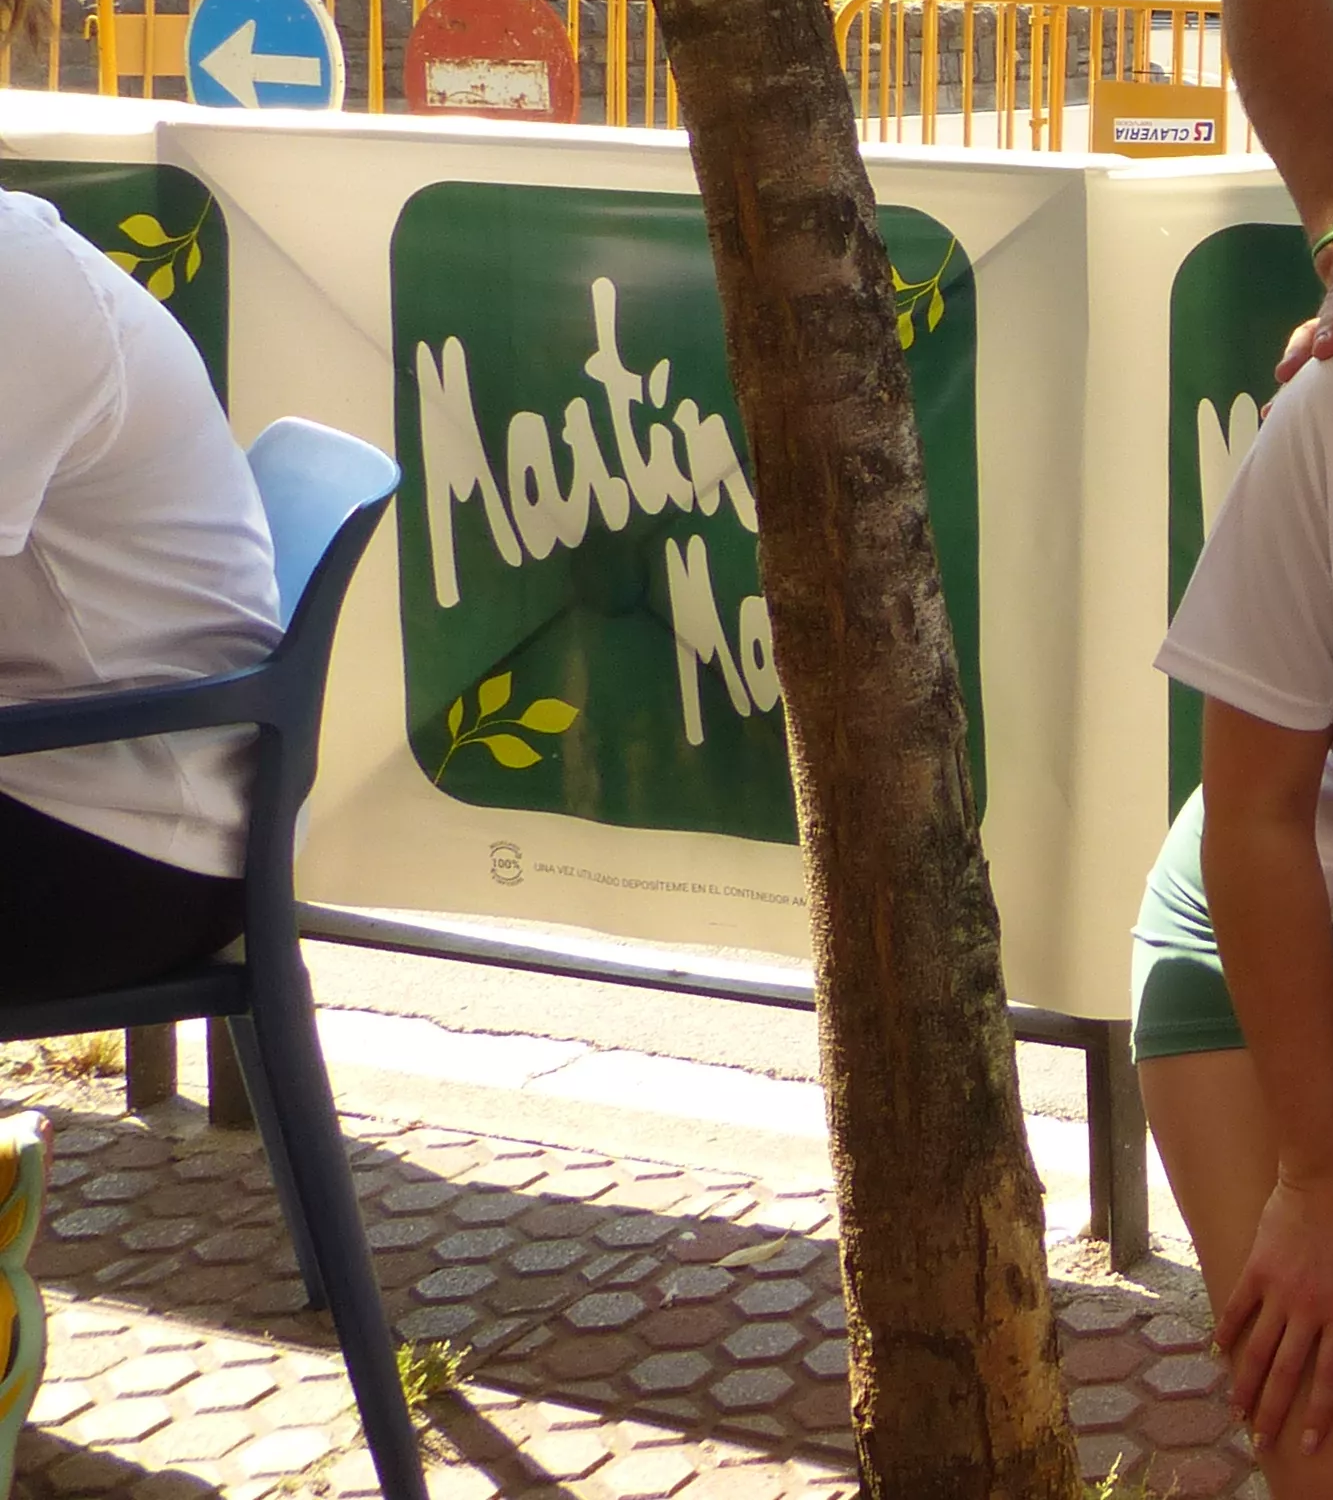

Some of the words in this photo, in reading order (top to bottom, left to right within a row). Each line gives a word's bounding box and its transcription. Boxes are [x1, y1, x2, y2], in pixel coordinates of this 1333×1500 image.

[1115, 128, 1190, 141] CLAVERIA
[491, 858, 521, 869] 100%
[533, 862, 556, 875] UNA
[556, 864, 576, 877] VEZ
[577, 868, 620, 887] UTILIZADO
[691, 882, 707, 894] EN
[708, 884, 722, 895] EL
[723, 885, 790, 905] CONTENEDOR
